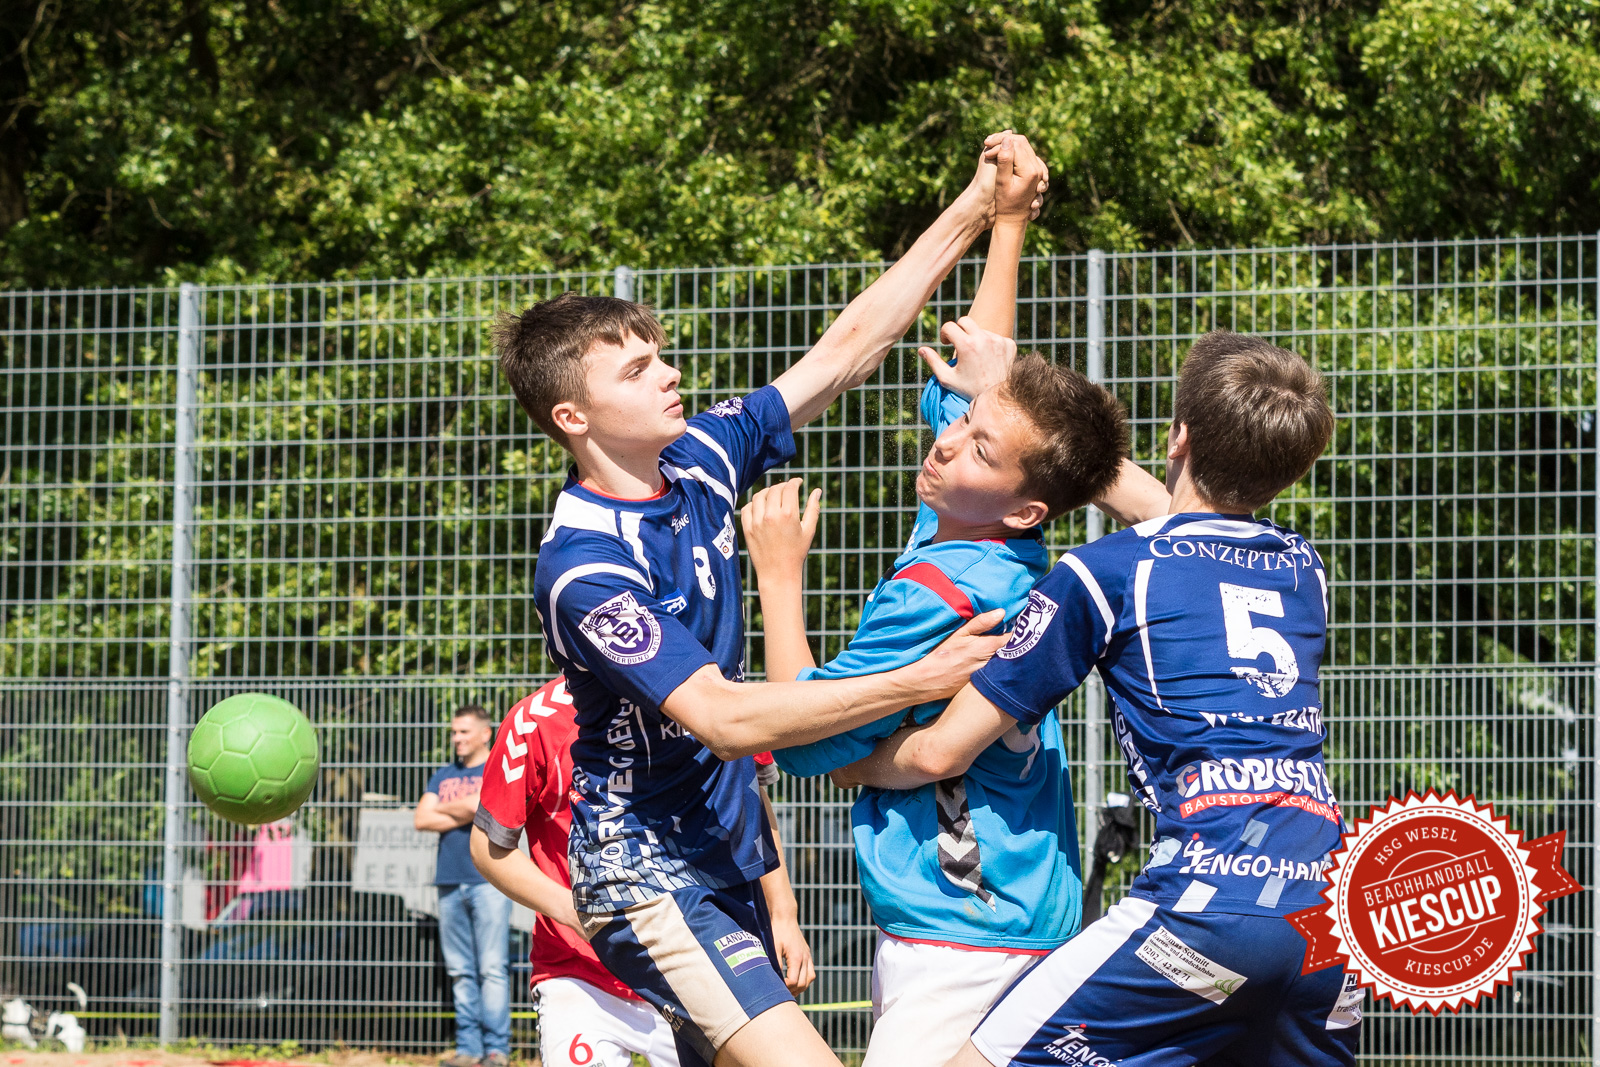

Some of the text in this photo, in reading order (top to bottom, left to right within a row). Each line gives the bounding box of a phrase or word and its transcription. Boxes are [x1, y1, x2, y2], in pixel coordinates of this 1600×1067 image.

[1219, 582, 1300, 698] 5
[1143, 944, 1160, 961] 0202
[1162, 960, 1173, 970] 42
[1171, 967, 1182, 976] 82
[1181, 972, 1191, 982] 71
[1159, 928, 1210, 968] Thomas Schmitt
[568, 1033, 594, 1066] 6
